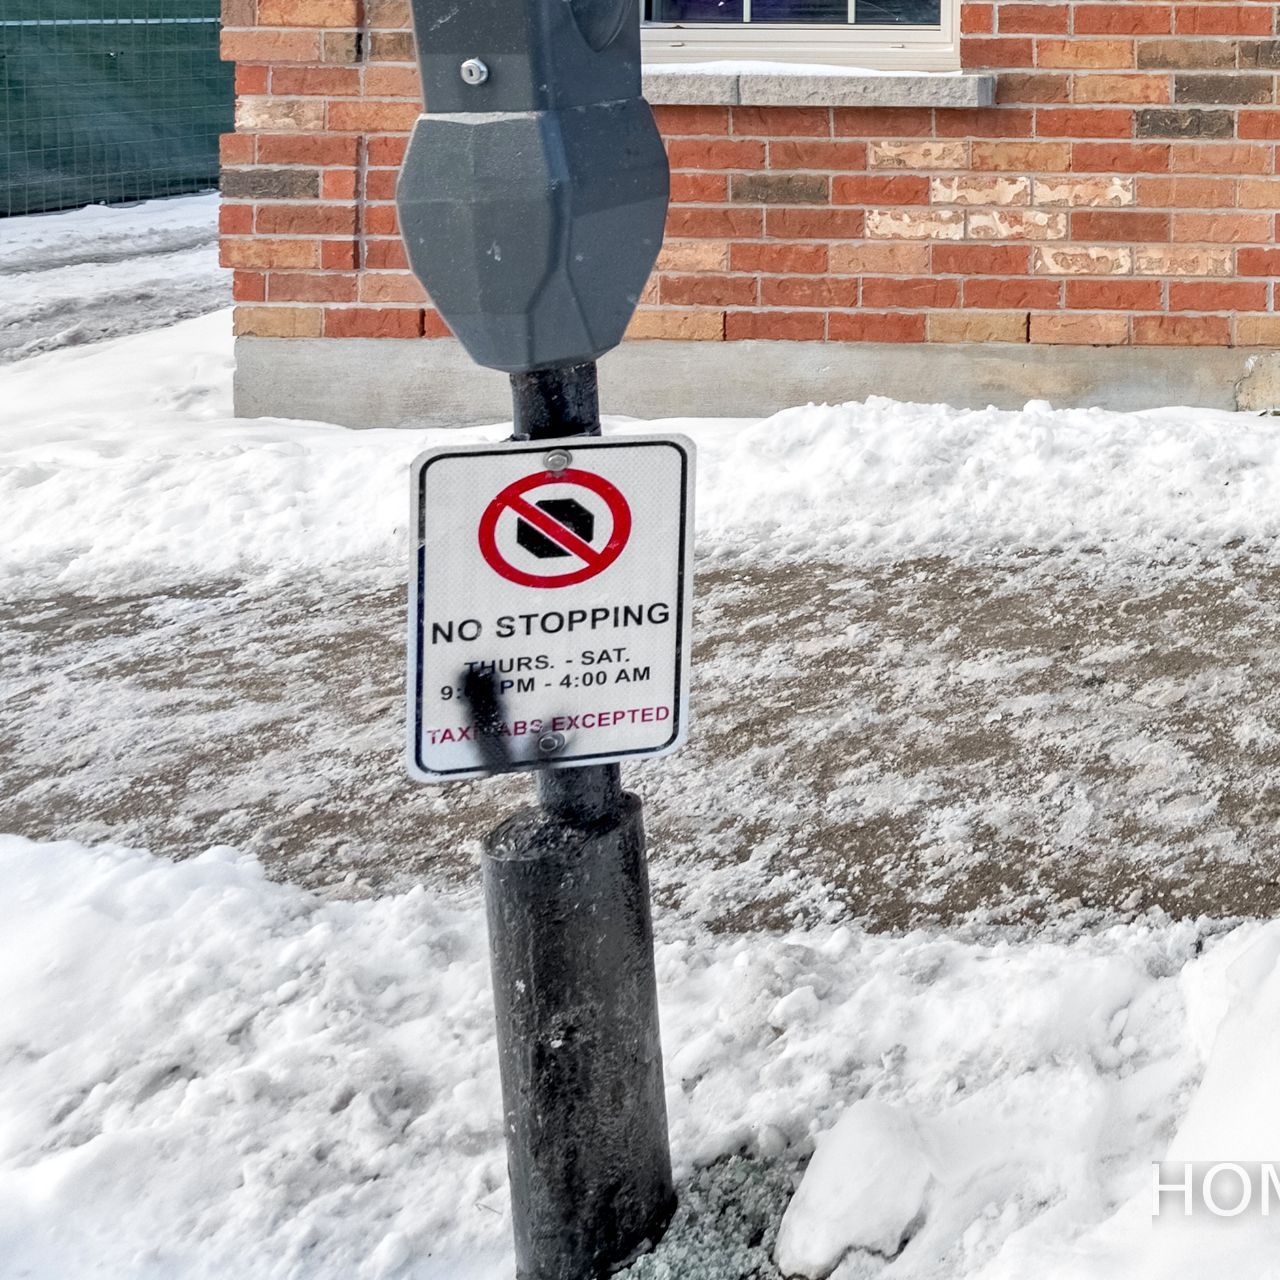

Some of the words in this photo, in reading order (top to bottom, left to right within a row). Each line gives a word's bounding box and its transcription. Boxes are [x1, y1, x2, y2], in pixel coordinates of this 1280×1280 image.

[431, 618, 482, 644] NO
[496, 602, 670, 638] STOPPING
[581, 647, 630, 666] SAT.
[500, 677, 535, 695] PM
[560, 670, 607, 689] 4:00
[614, 666, 650, 684] AM
[551, 705, 669, 732] EXCEPTED
